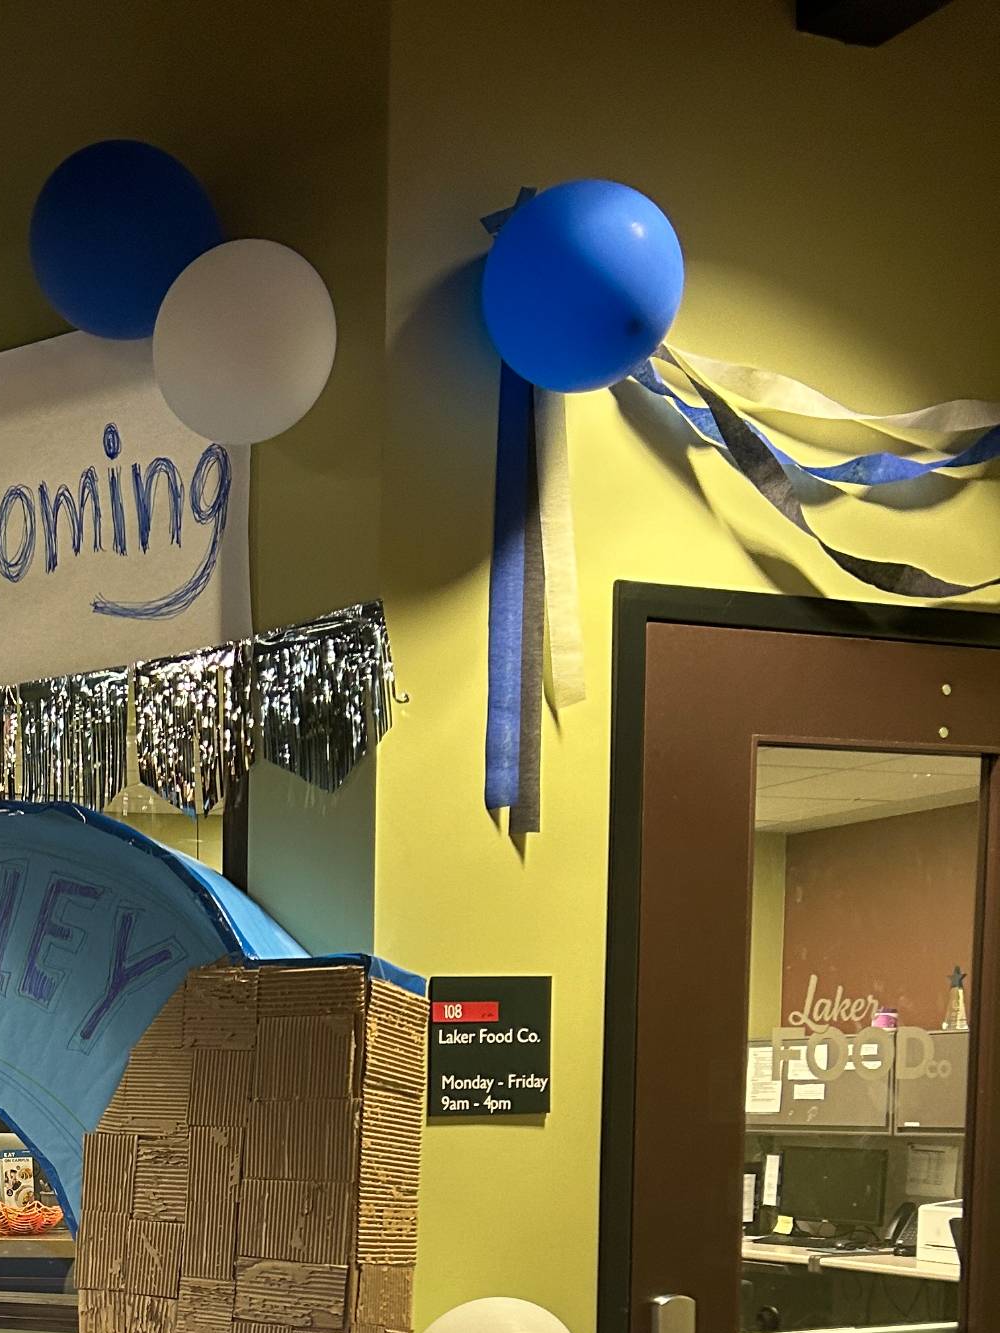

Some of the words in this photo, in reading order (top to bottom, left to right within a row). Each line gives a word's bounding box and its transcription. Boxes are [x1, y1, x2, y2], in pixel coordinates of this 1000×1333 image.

[443, 1004, 463, 1019] 108
[788, 974, 879, 1033] Laker
[438, 1029, 476, 1045] Laker
[479, 1028, 513, 1044] Food
[516, 1028, 541, 1043] Co.
[771, 1026, 935, 1081] FOOD
[441, 1075, 495, 1093] Monday
[508, 1074, 549, 1092] Friday
[441, 1096, 470, 1111] 9am
[483, 1095, 512, 1113] 4pm
